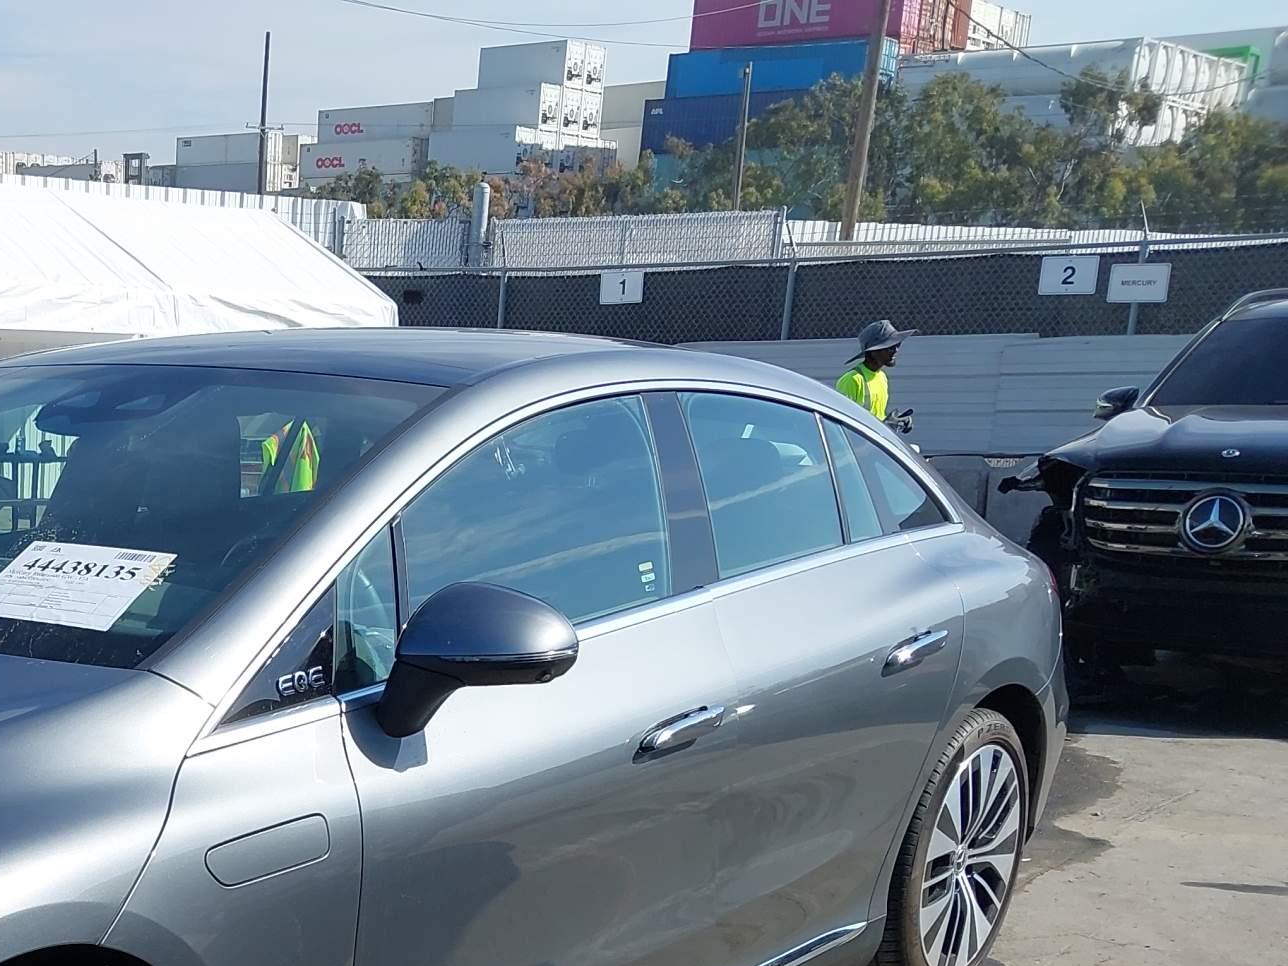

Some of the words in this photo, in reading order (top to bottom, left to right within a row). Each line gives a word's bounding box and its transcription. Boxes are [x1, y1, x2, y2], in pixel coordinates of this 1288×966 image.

[757, 0, 831, 28] ONE
[334, 122, 364, 135] OOCL
[316, 156, 345, 169] OOCL
[1061, 266, 1076, 285] 2
[1121, 279, 1158, 287] MERCURY
[619, 278, 626, 295] 1
[23, 557, 143, 581] 44438135
[278, 665, 325, 696] EQE
